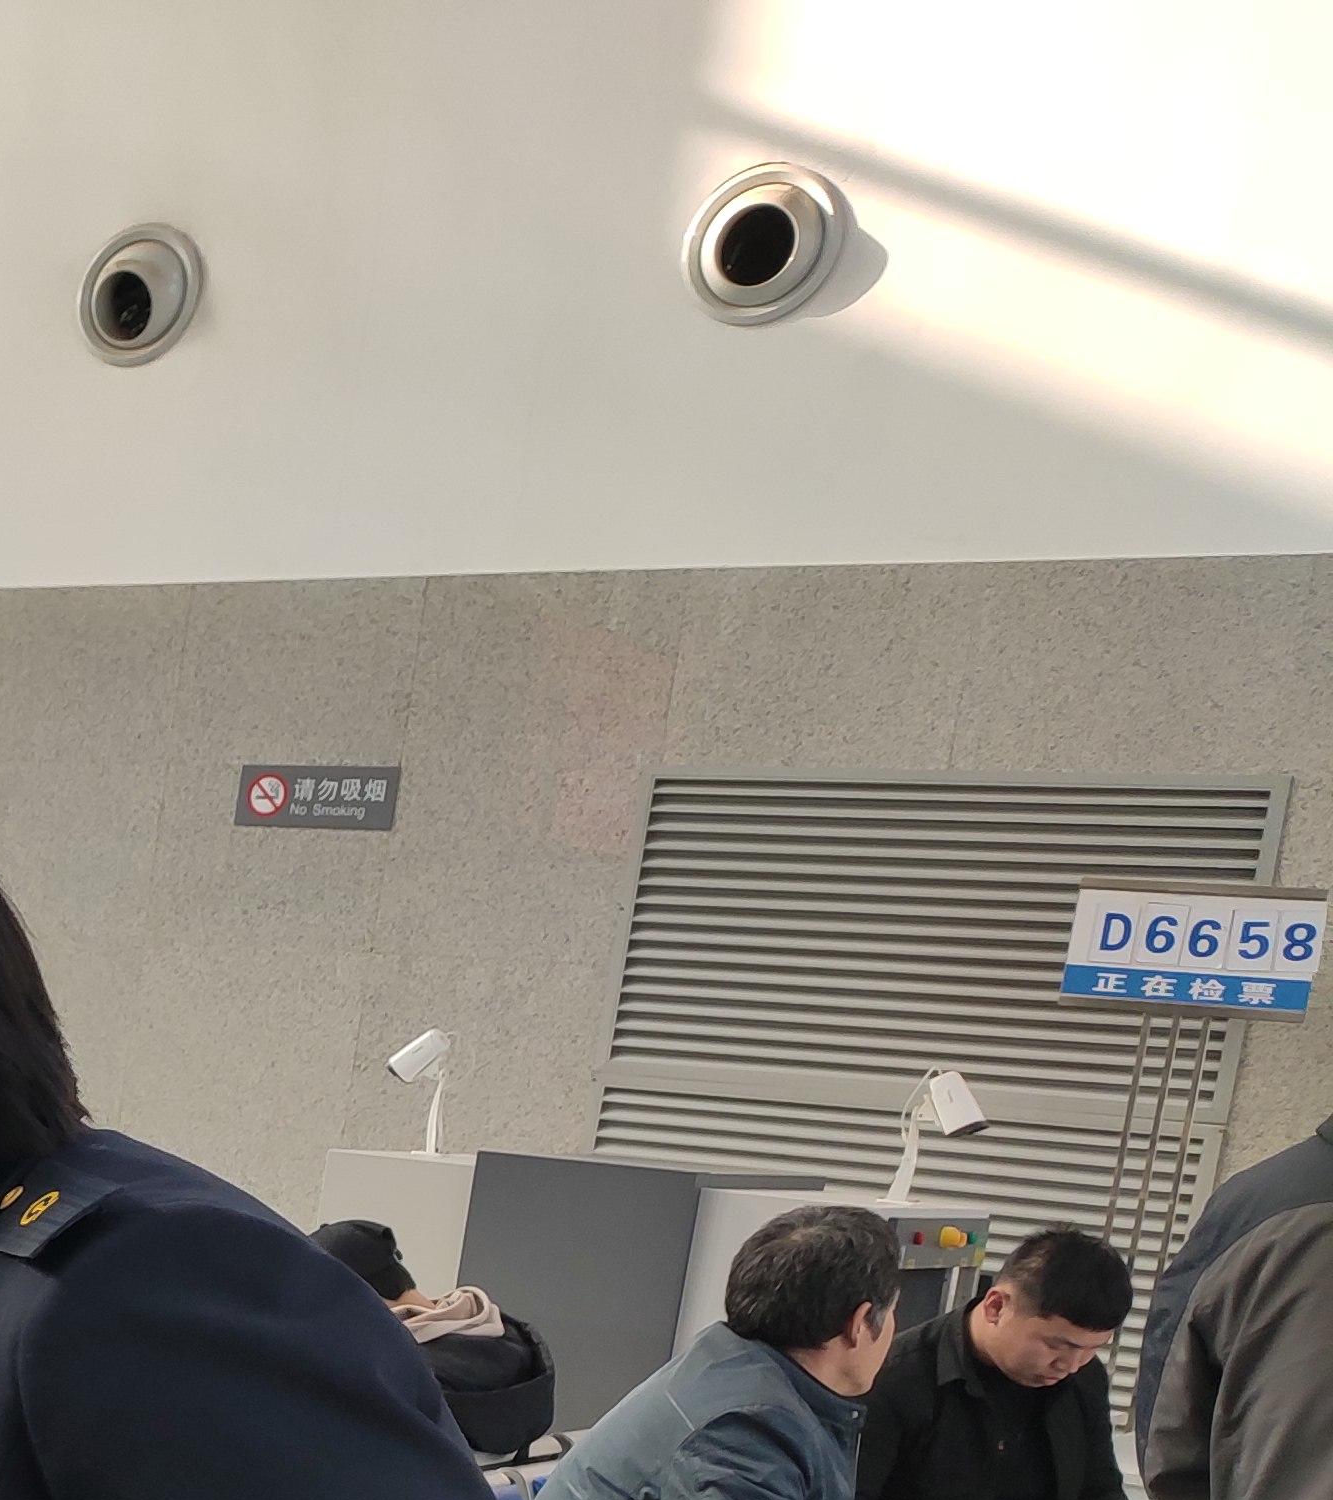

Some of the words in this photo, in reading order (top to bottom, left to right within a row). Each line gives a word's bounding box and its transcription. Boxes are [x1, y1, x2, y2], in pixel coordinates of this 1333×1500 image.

[293, 778, 388, 802] 请勿吸烟
[289, 803, 307, 816] No
[312, 803, 366, 820] Smoking
[1099, 912, 1317, 962] D6658
[1091, 971, 1277, 1005] 正在检票
